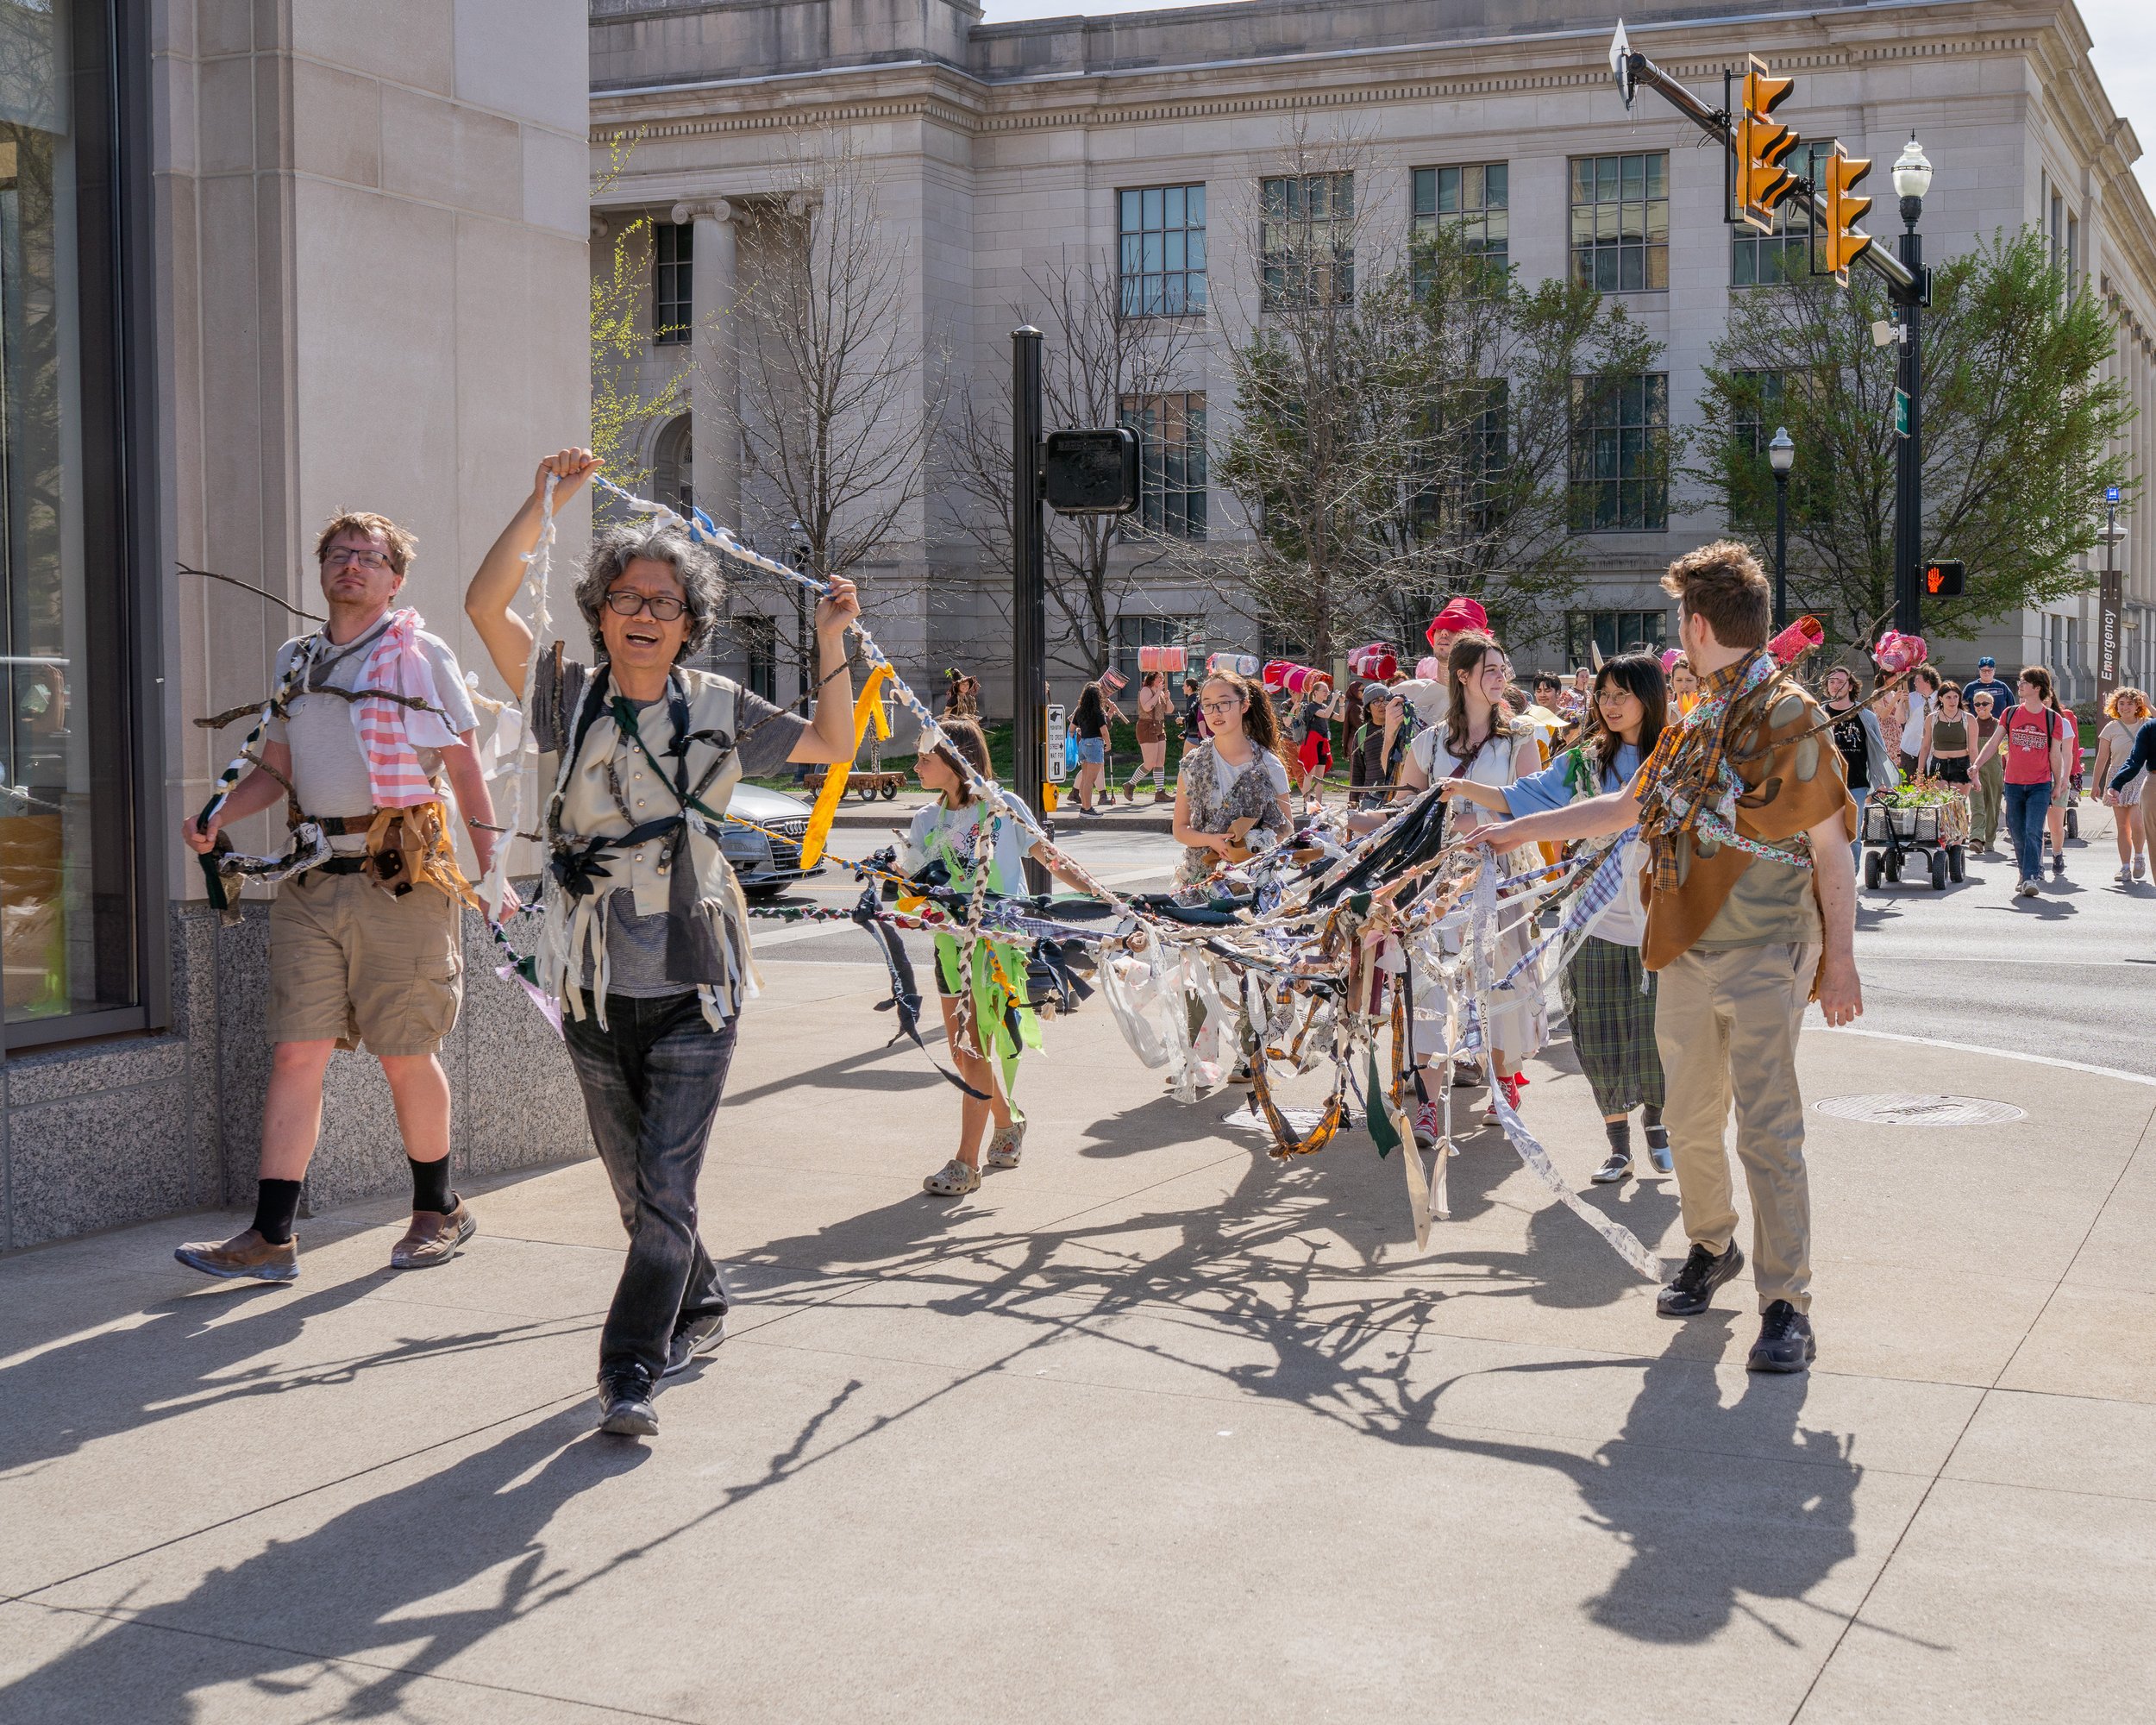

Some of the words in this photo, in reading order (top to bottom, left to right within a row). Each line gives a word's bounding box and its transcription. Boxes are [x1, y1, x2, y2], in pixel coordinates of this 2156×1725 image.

[2101, 609, 2116, 681] Emergency
[2012, 738, 2045, 749] BUCKEYES
[2028, 735, 2046, 743] STATE
[1480, 1002, 1489, 1037] Coffee
